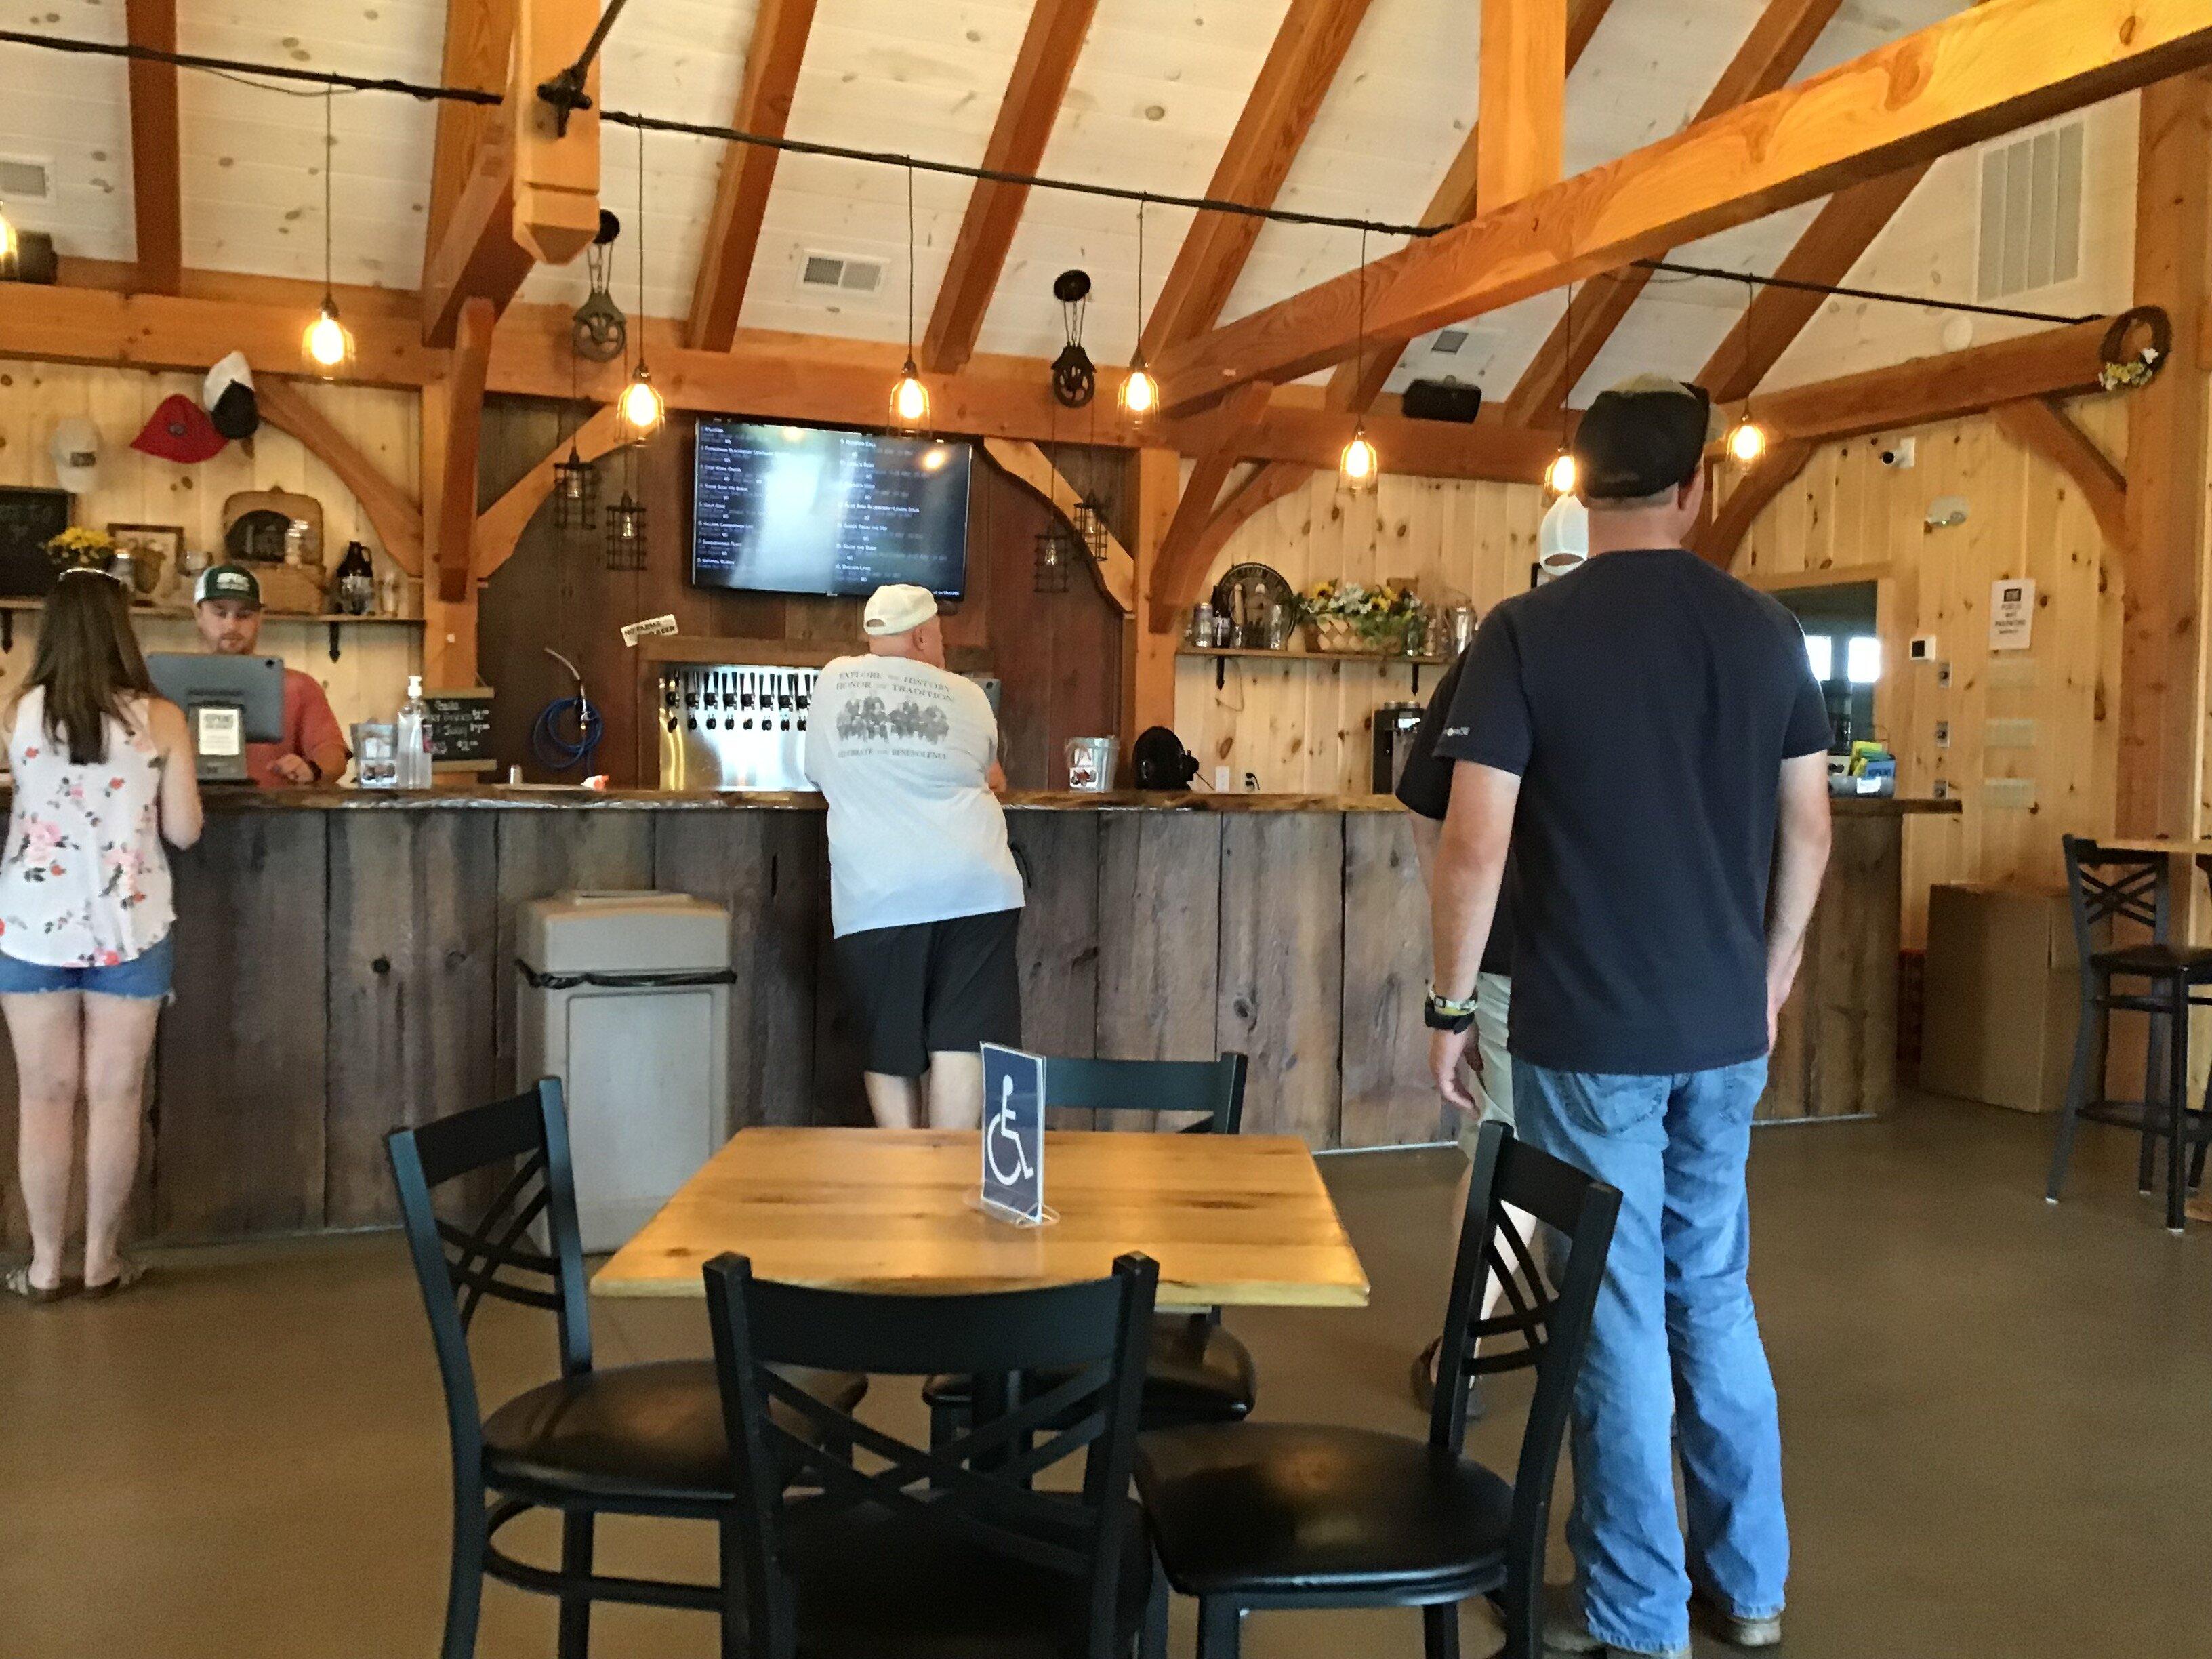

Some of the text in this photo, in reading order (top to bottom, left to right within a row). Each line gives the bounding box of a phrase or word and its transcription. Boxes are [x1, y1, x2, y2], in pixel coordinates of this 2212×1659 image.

[836, 681, 872, 691] HONOR
[891, 684, 954, 703] TRADITION
[838, 671, 881, 680] EXPLORE
[903, 676, 951, 693] HISTORY
